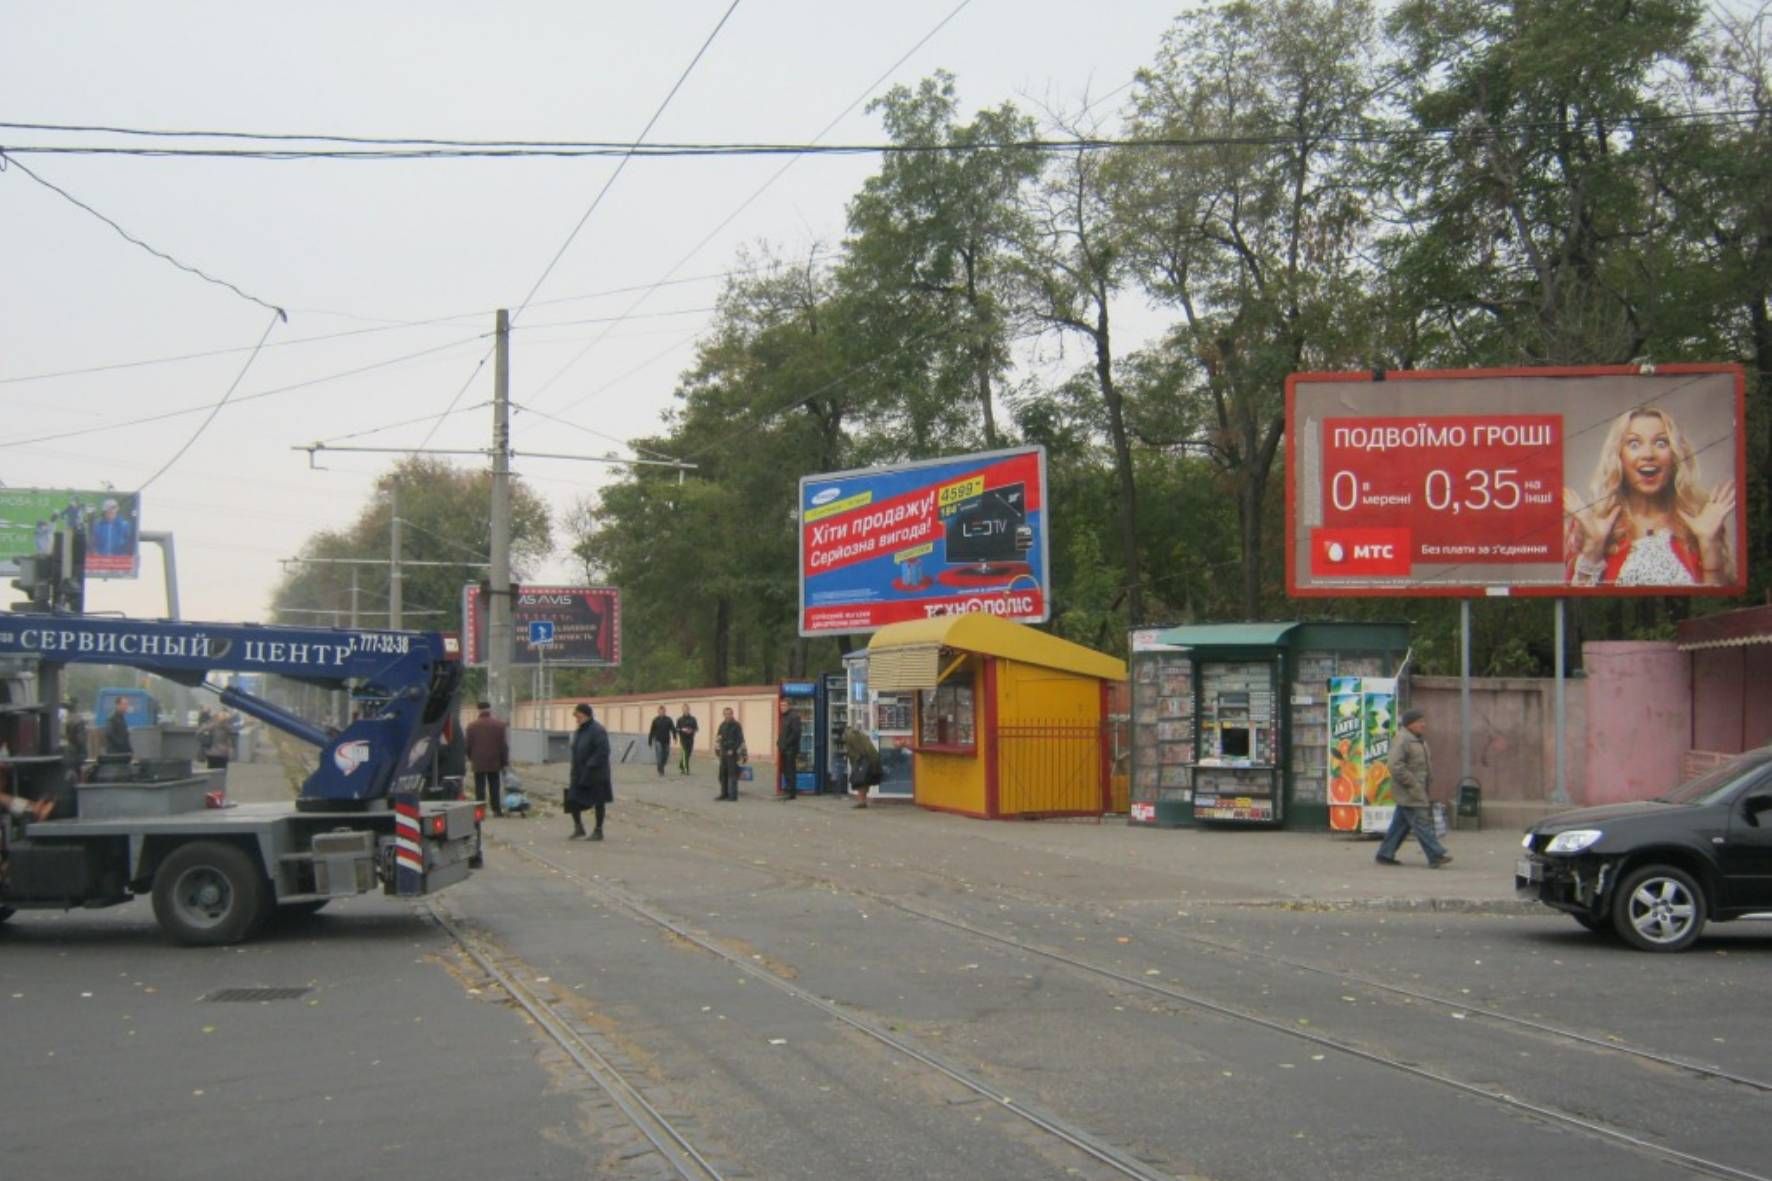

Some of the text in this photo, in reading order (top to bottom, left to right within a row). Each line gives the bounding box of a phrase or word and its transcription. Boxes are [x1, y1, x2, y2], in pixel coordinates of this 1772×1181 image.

[1334, 424, 1551, 452] ПОДВОЇМО ГРОШІ
[1332, 470, 1358, 512] 0
[1425, 469, 1520, 514] 0,35
[812, 522, 849, 546] Хіти
[852, 490, 936, 537] продажу!
[810, 537, 875, 567] Серйозна
[879, 517, 932, 547] вигода!
[1353, 544, 1394, 560] МТС
[1421, 544, 1441, 555] Без
[20, 629, 211, 658] СЕРВИСНЫЙ
[244, 640, 351, 665] ЦЕНТР
